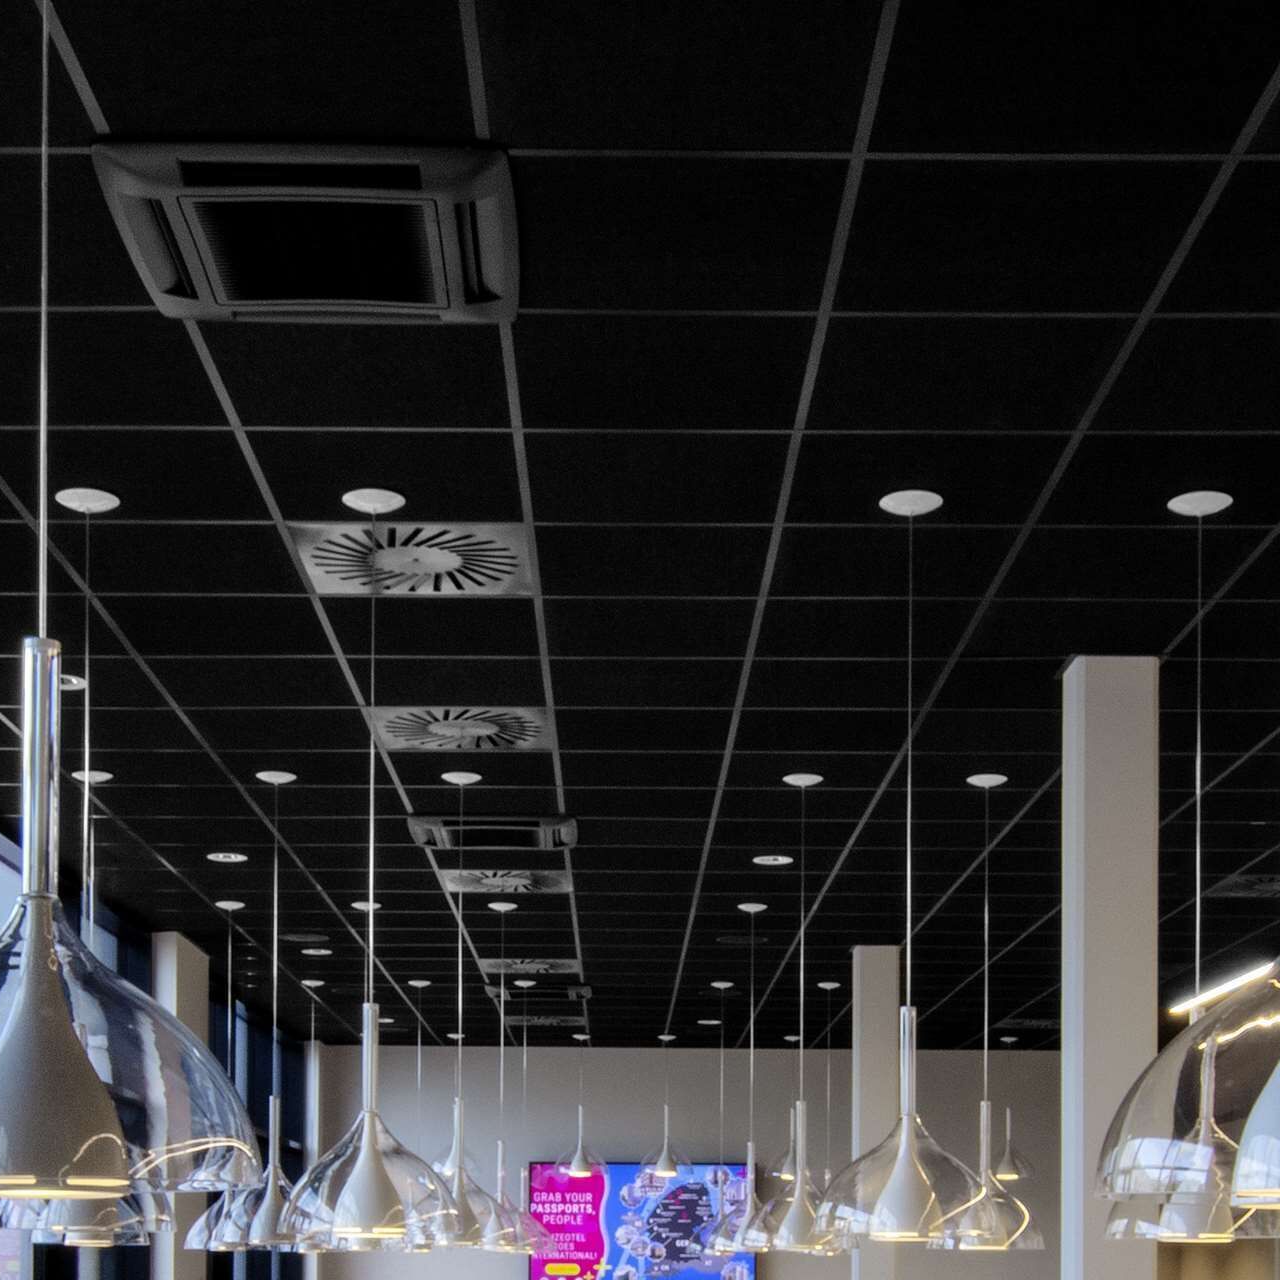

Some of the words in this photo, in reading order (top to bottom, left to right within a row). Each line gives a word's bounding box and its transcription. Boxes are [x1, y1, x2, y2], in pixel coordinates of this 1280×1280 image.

[533, 1191, 562, 1202] GRAB
[564, 1191, 593, 1202] YOUR
[542, 1214, 583, 1225] PEOPLE
